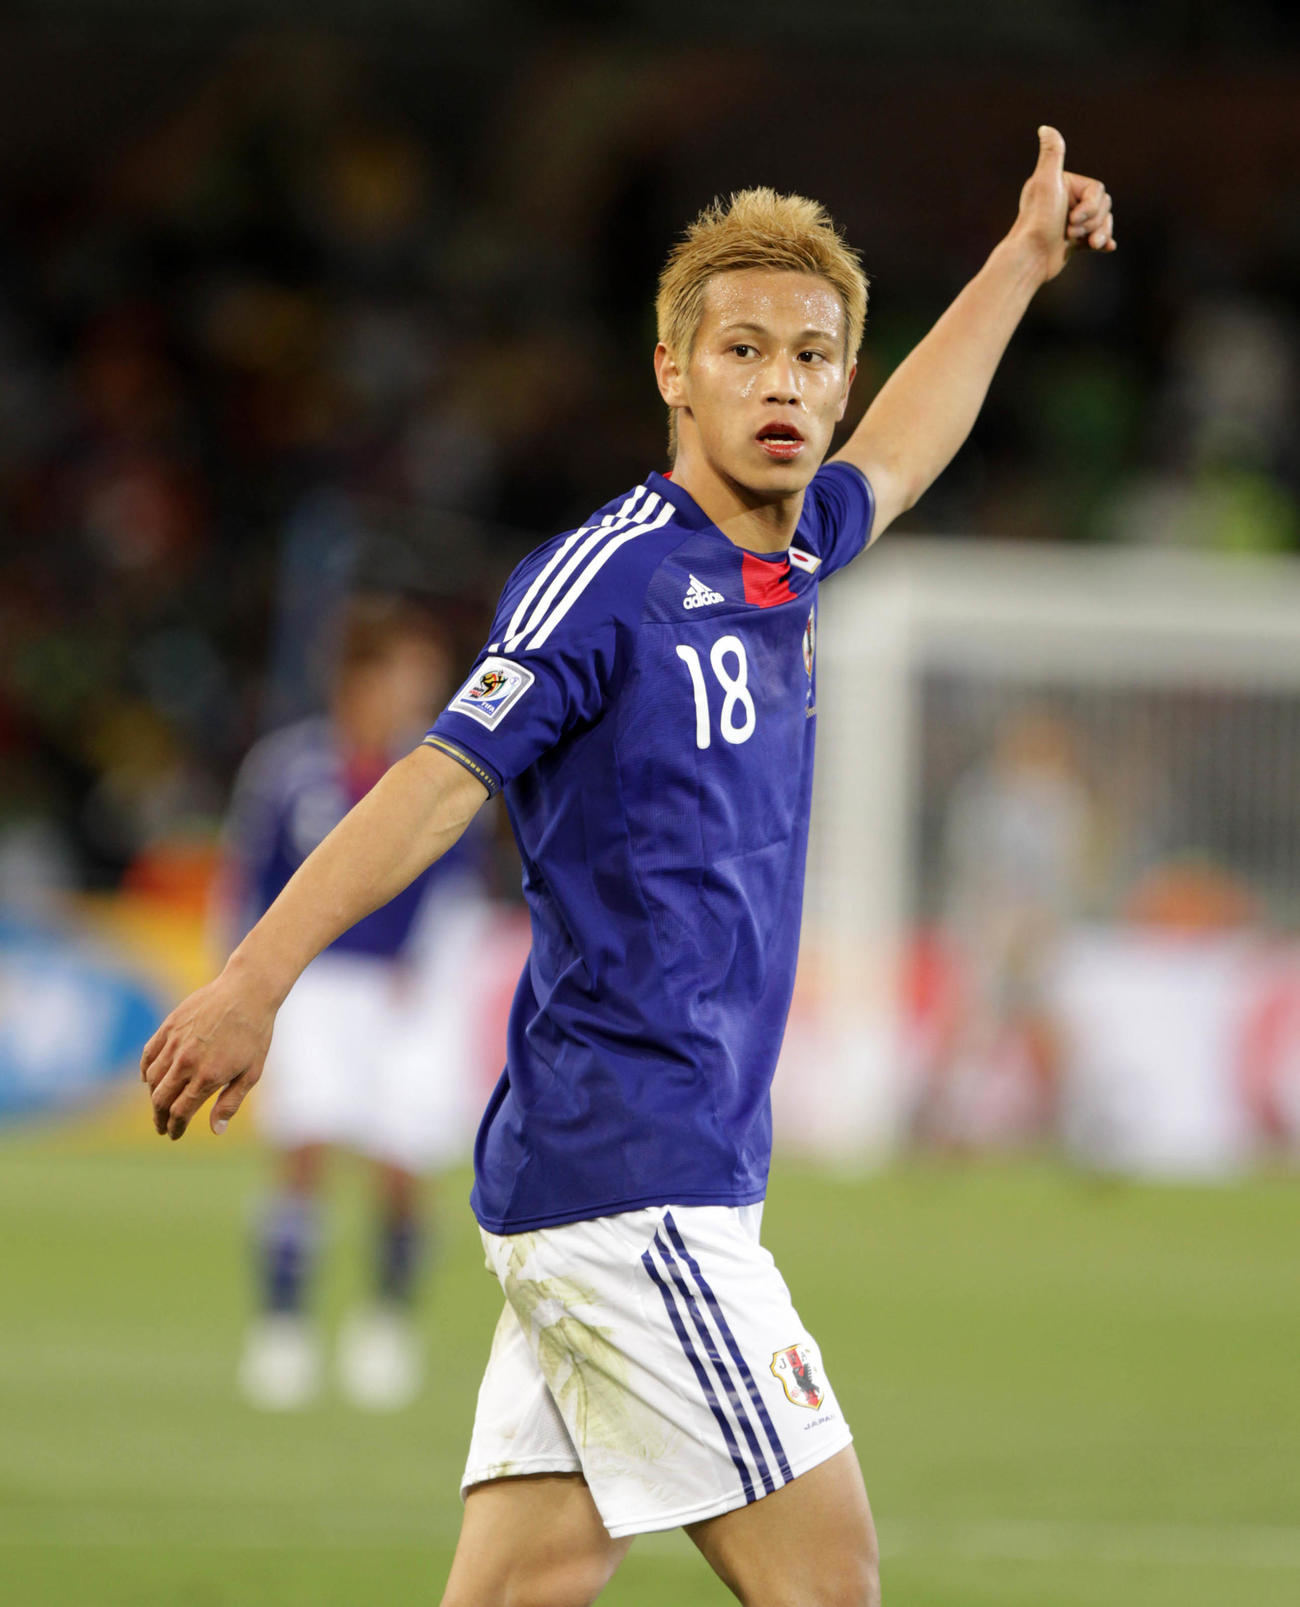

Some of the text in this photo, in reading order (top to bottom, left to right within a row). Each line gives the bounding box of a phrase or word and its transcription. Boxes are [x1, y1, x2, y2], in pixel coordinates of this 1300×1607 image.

[683, 591, 725, 610] adidas
[676, 635, 756, 749] 18
[804, 1415, 834, 1430] JAPA
